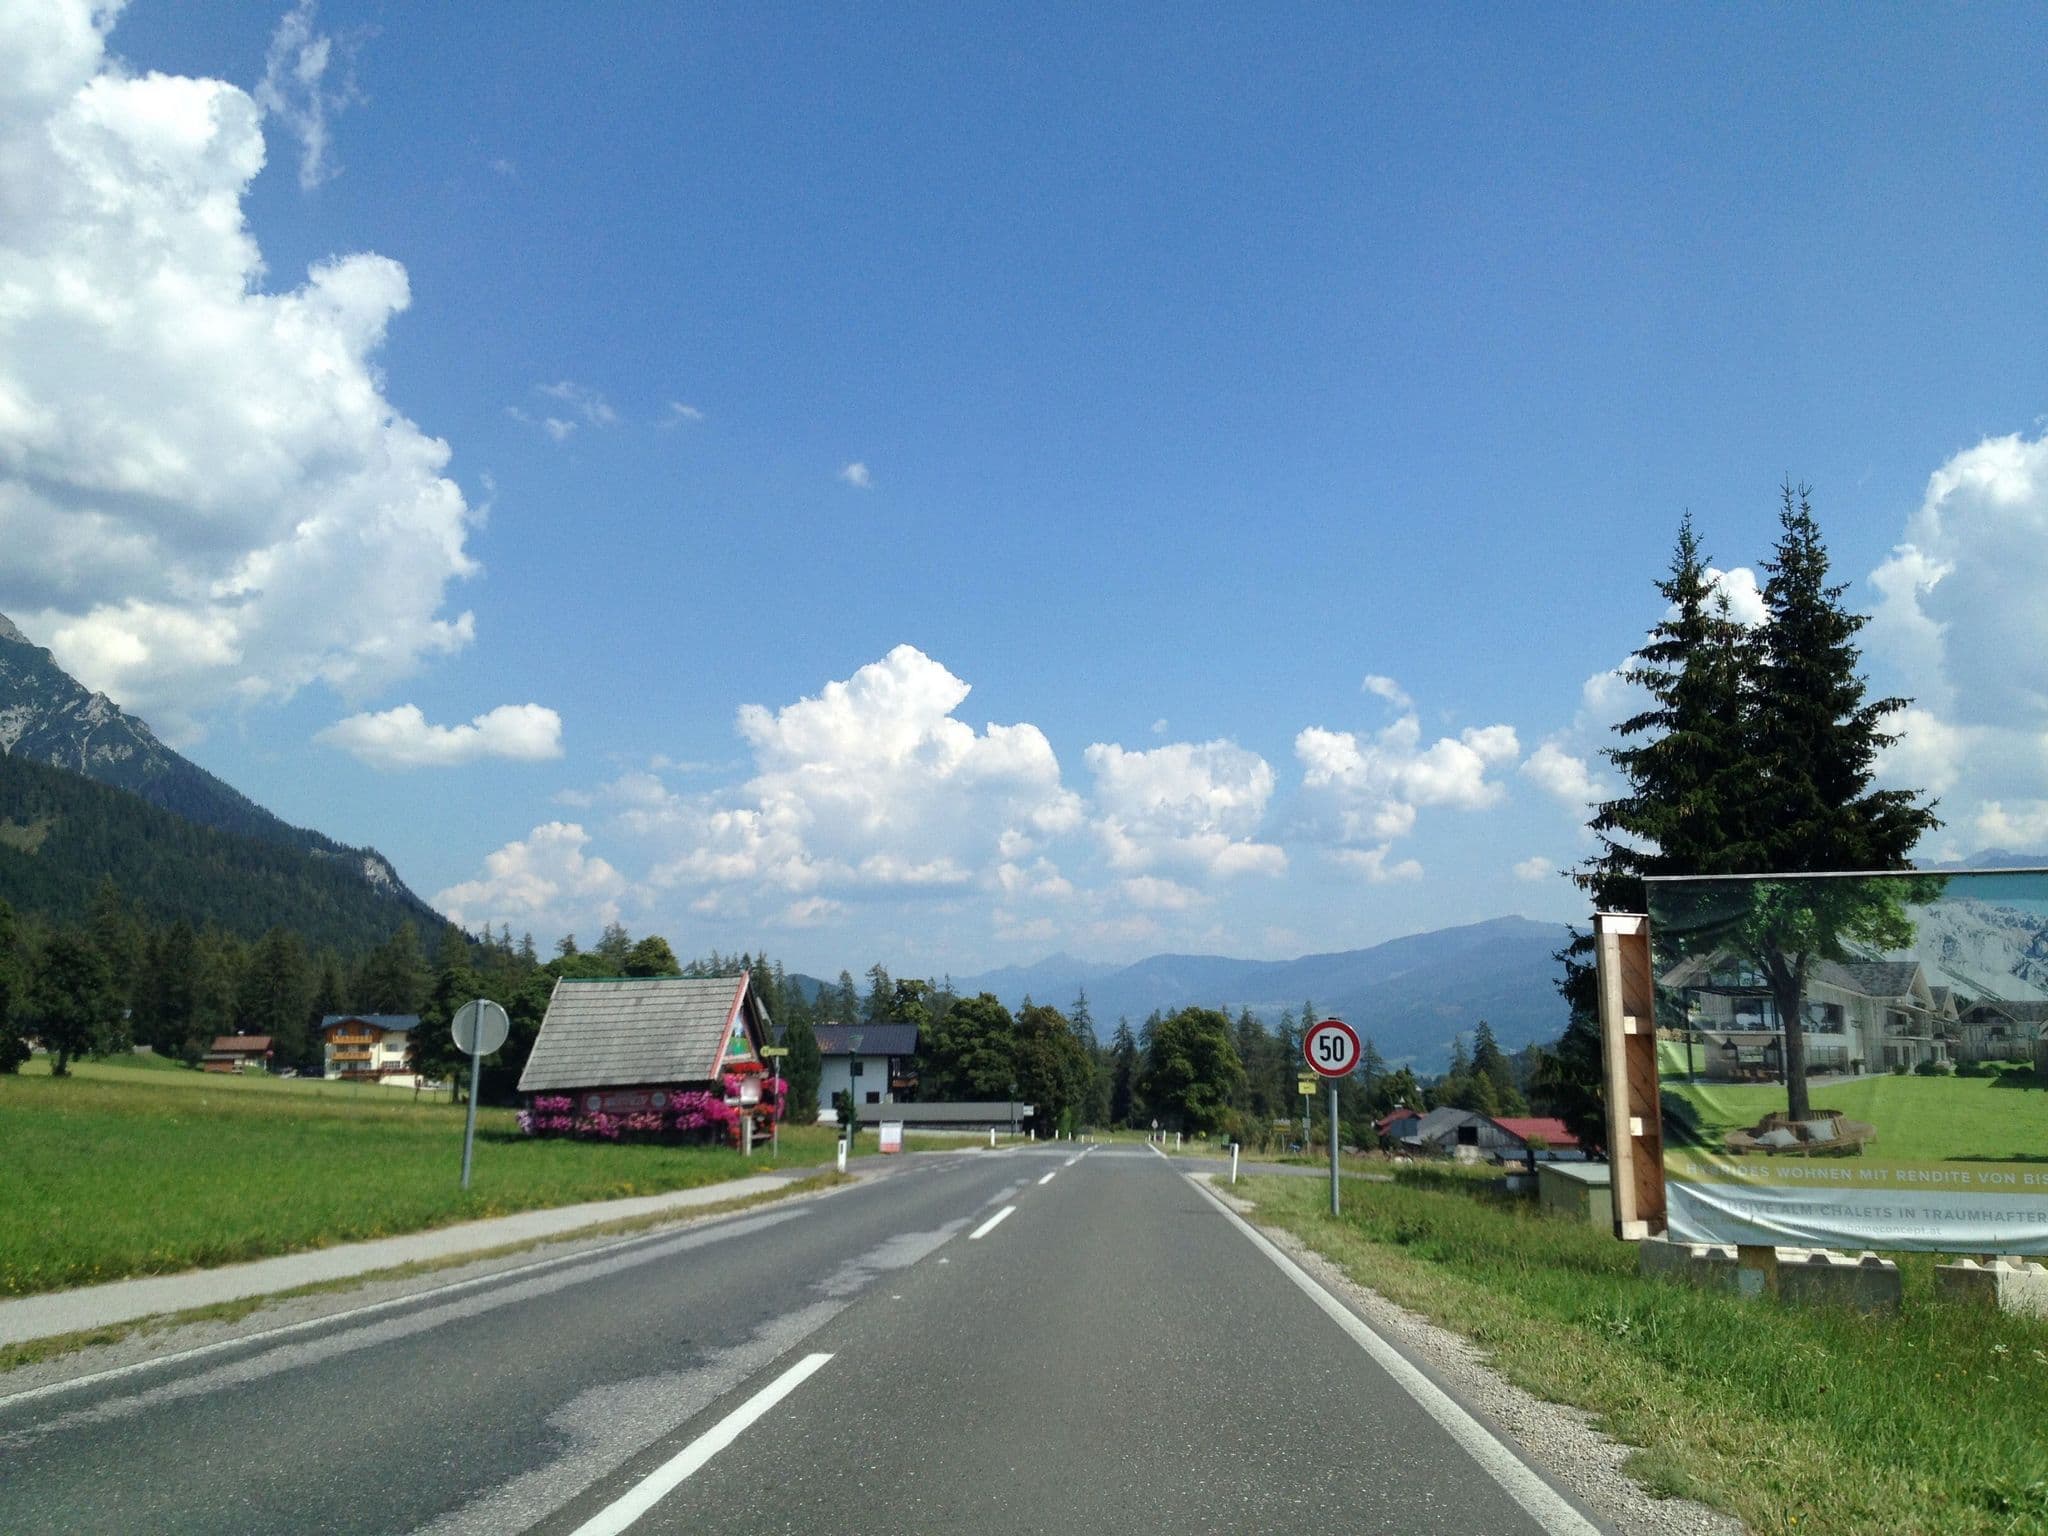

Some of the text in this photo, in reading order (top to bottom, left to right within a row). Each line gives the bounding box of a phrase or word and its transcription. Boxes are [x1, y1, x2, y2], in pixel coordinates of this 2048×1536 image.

[1319, 1035, 1345, 1062] 50
[1777, 1166, 1852, 1180] WOHNEN
[1859, 1169, 1888, 1181] MIT
[1896, 1170, 1970, 1184] RENDITE
[1978, 1172, 2016, 1185] VON
[1782, 1202, 1812, 1216] ALM
[1820, 1203, 1893, 1218] CHALETS
[1898, 1207, 1916, 1220] IN
[1921, 1208, 2047, 1224] TRAUMHAFTER
